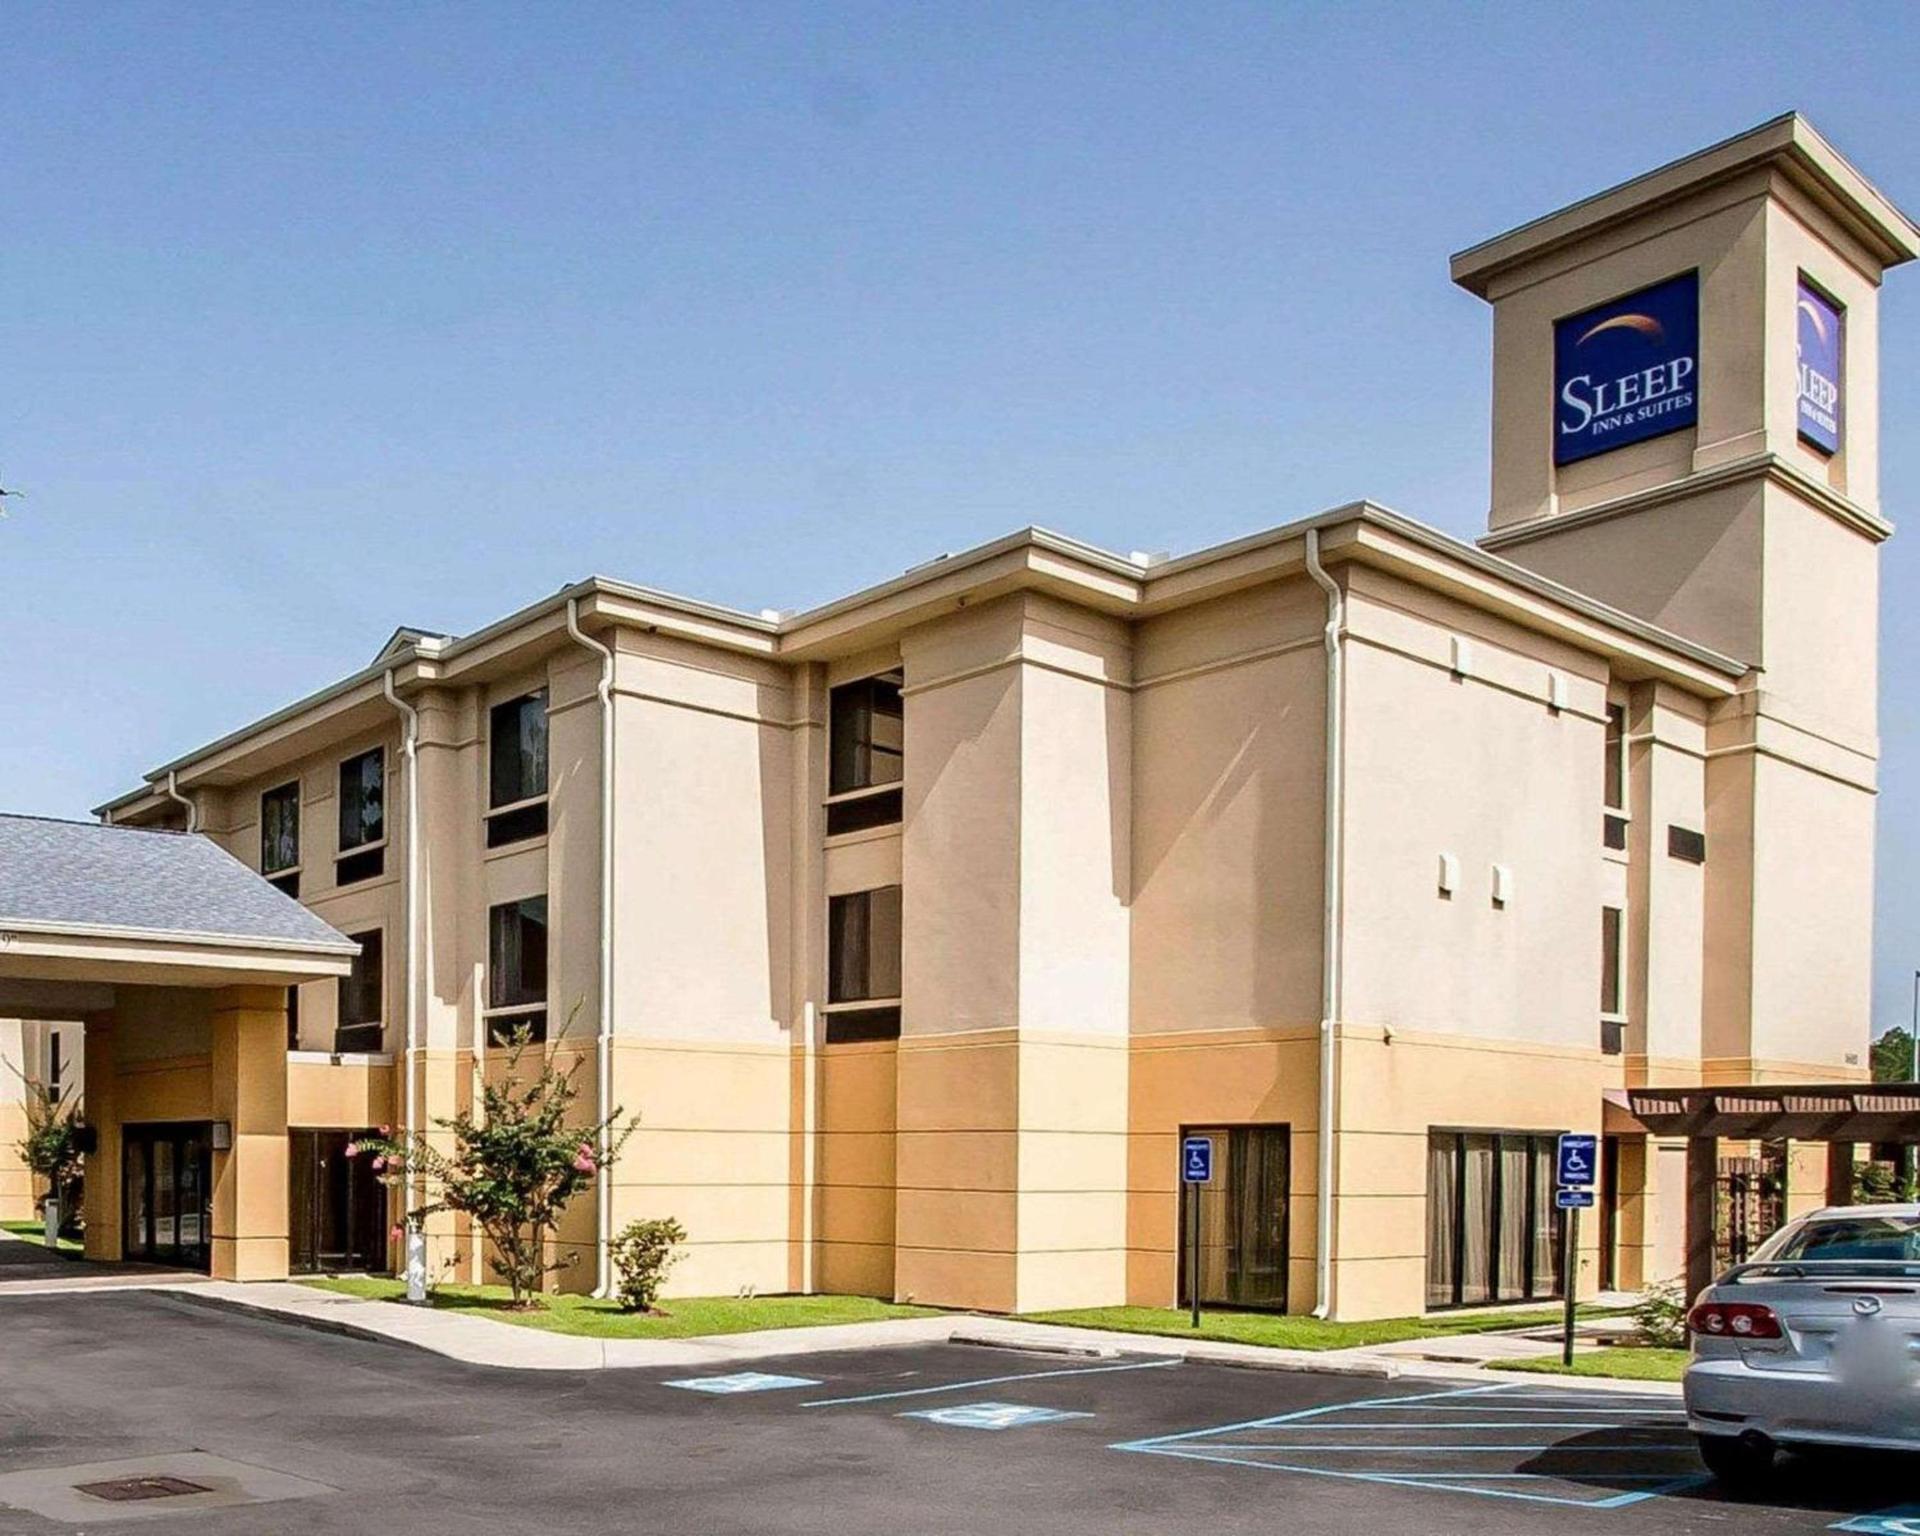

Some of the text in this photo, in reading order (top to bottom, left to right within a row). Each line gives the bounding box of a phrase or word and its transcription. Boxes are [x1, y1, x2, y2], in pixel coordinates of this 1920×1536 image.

[1561, 356, 1694, 434] SLEEP
[1592, 391, 1693, 435] INN & SUITES
[1796, 344, 1837, 414] LEEP
